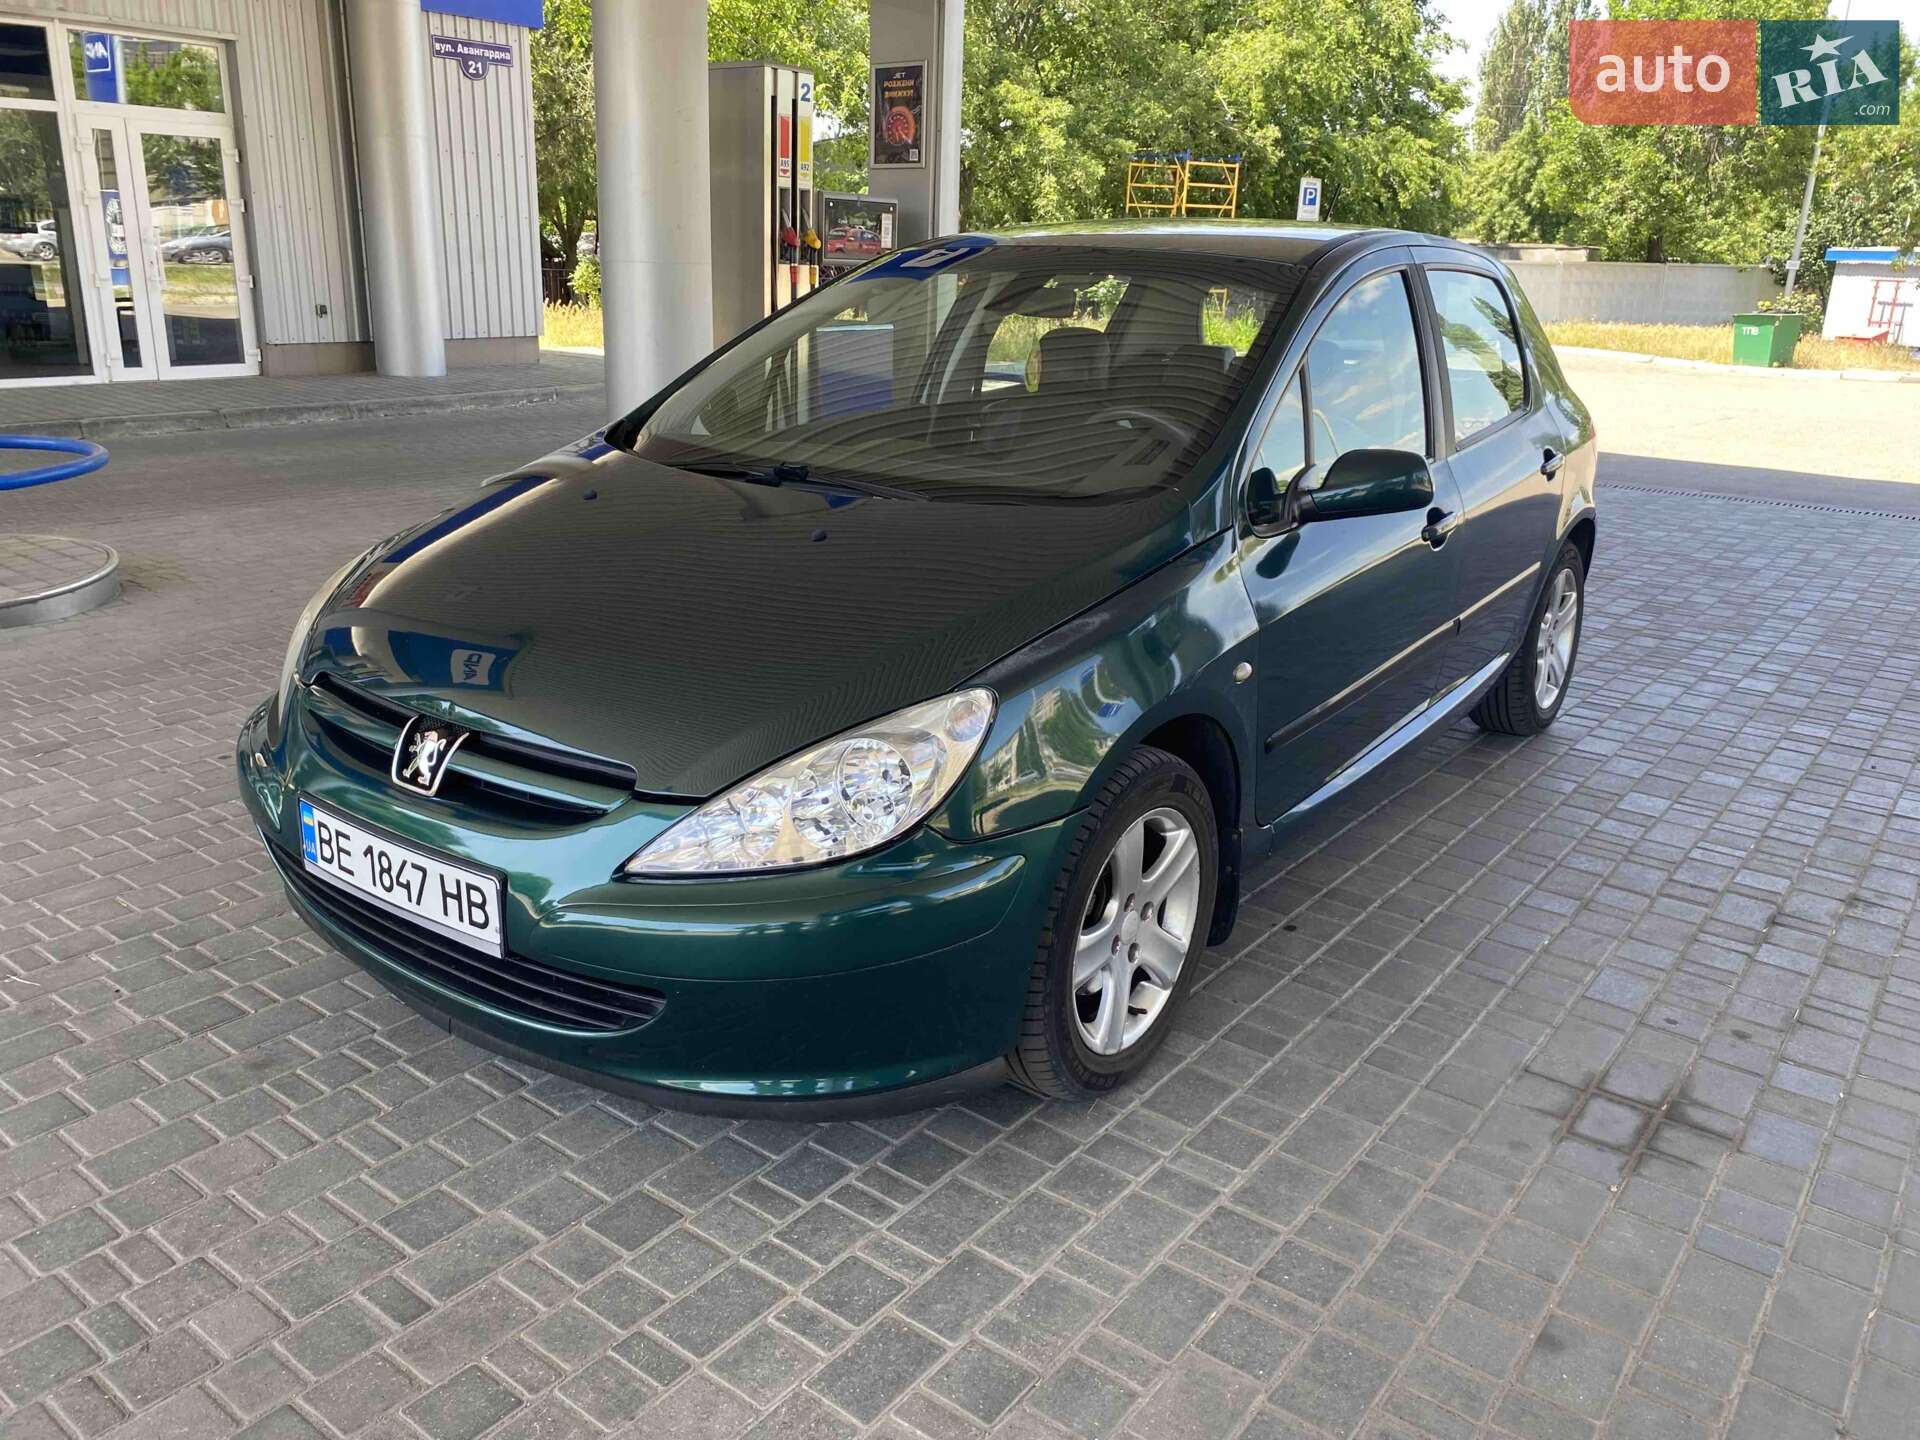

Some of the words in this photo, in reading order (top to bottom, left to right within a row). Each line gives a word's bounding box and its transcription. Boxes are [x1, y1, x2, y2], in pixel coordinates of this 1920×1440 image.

[435, 42, 455, 53] вул.
[457, 43, 511, 60] Авангардна
[468, 60, 482, 74] 21
[800, 83, 811, 102] 2
[1305, 189, 1316, 205] P
[305, 838, 316, 854] UA
[318, 820, 355, 877] BE
[363, 845, 428, 906] 1847
[439, 873, 490, 930] HB
